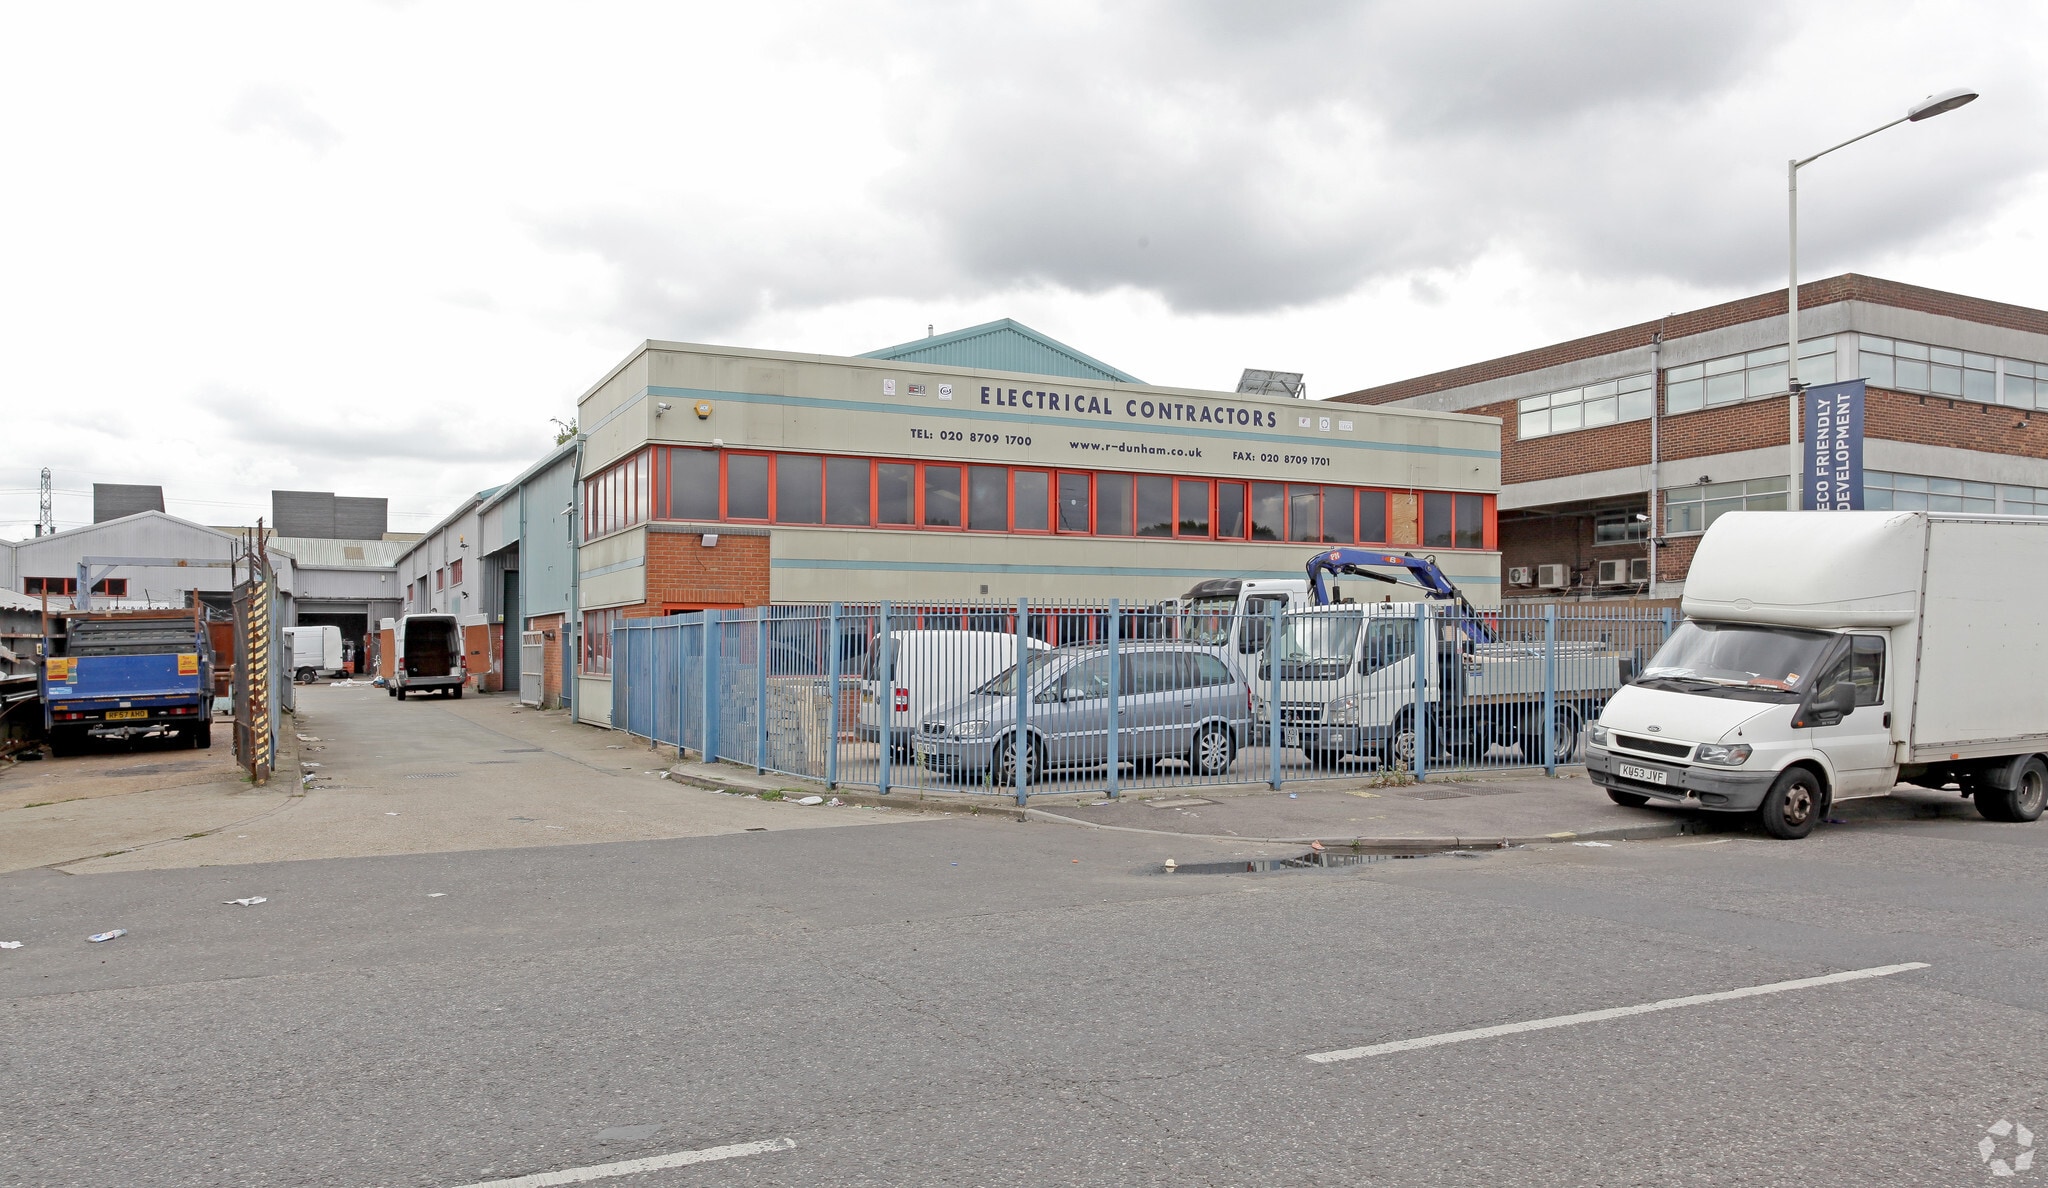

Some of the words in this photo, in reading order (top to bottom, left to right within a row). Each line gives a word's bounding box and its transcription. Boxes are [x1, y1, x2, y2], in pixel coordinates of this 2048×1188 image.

[980, 386, 1112, 415] ELECTRICAL
[1126, 399, 1277, 428] CONTRACTORS
[910, 428, 933, 440] TEL:
[940, 430, 963, 442] 020
[969, 432, 1000, 444] 8709
[1005, 435, 1032, 447] 1700
[1816, 399, 1831, 477] FRIENDLY
[1069, 441, 1203, 458] www.r-dunham.co.uk
[1232, 451, 1256, 462] FAX:
[1260, 453, 1279, 463] 020
[1284, 454, 1308, 465] 8709
[1310, 456, 1330, 467] 1701
[1816, 484, 1830, 511] ECO
[1623, 765, 1645, 778] KU53
[1646, 768, 1664, 782] JVF
